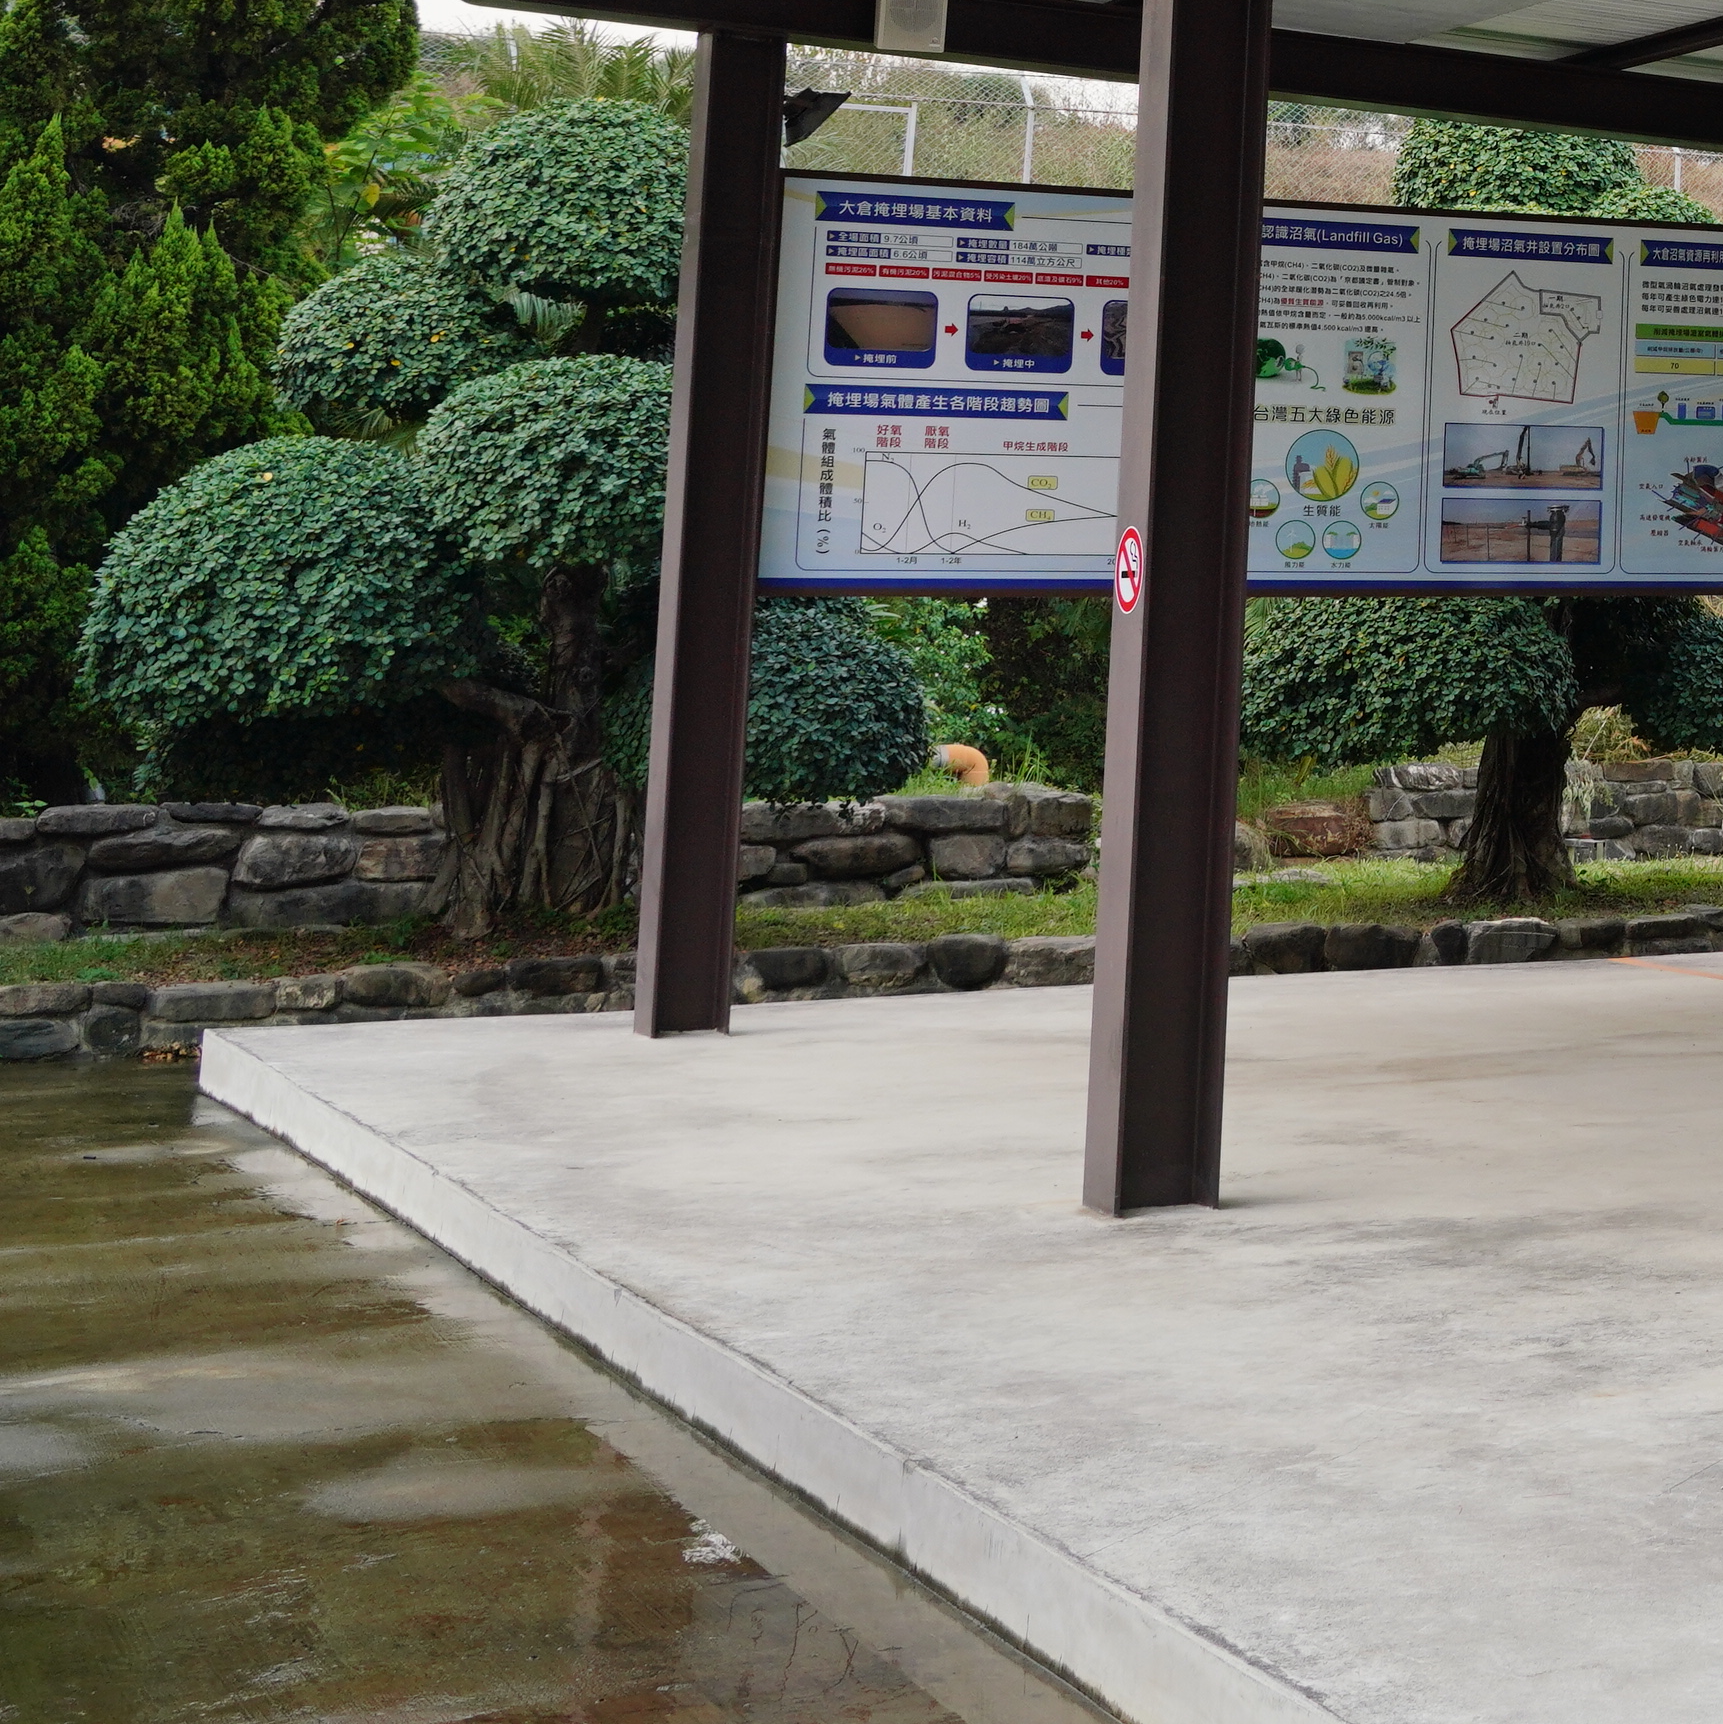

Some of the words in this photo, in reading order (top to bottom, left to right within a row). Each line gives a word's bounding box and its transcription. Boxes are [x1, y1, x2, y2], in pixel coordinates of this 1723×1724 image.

[839, 200, 993, 223] 大倉掩埋場基本資料
[838, 231, 880, 243] 全場面積
[883, 234, 918, 245] 9.7公頃
[968, 239, 1009, 250] 掩埋數量
[1373, 232, 1403, 247] Gas)
[836, 246, 890, 258] 掩埋區面積
[893, 250, 928, 260] 6.6公頃
[1462, 235, 1600, 258] 掩埋場沼氣井設置分布圖
[967, 253, 1007, 265] 掩埋容積
[1010, 255, 1076, 267] 114萬立方公尺
[862, 353, 898, 365] 掩埋前
[1002, 358, 1036, 369] 掩埋中
[1670, 362, 1680, 370] 70
[827, 390, 1050, 414] 掩埋場氣體產生各階段趨勢圖
[1253, 405, 1396, 425] 台灣五大綠色能源
[877, 424, 902, 436] 好氧
[876, 436, 902, 449] 階段
[924, 437, 950, 449] 階段
[1002, 440, 1069, 452] 甲烷生成階段
[1303, 504, 1341, 517] 生質能
